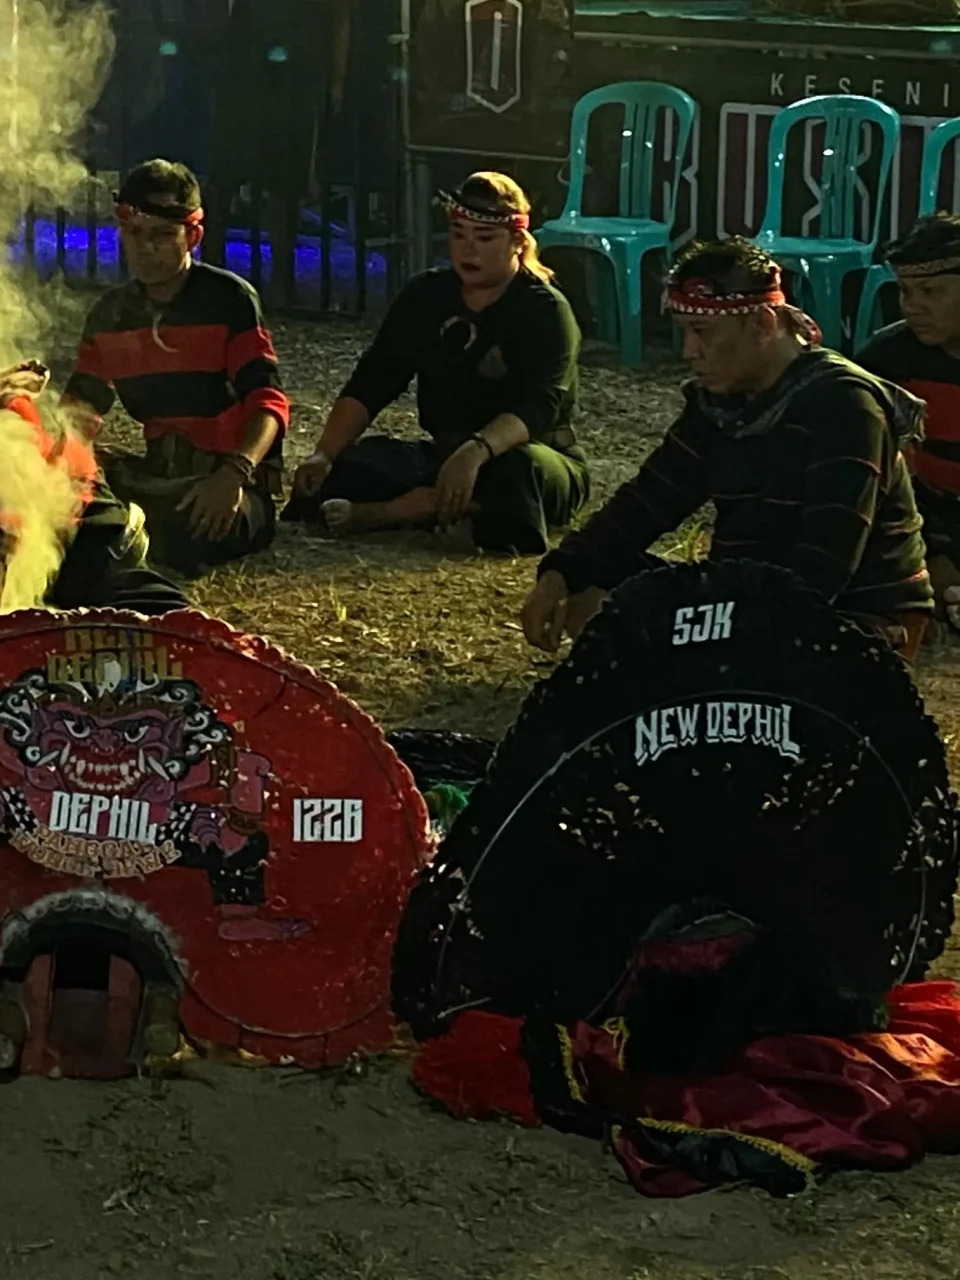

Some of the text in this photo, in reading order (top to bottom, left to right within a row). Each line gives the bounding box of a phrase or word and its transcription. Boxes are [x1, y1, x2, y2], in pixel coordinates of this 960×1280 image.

[672, 601, 735, 646] SJK
[635, 702, 801, 766] NEW DEPHIL
[49, 790, 158, 845] DEPHIL
